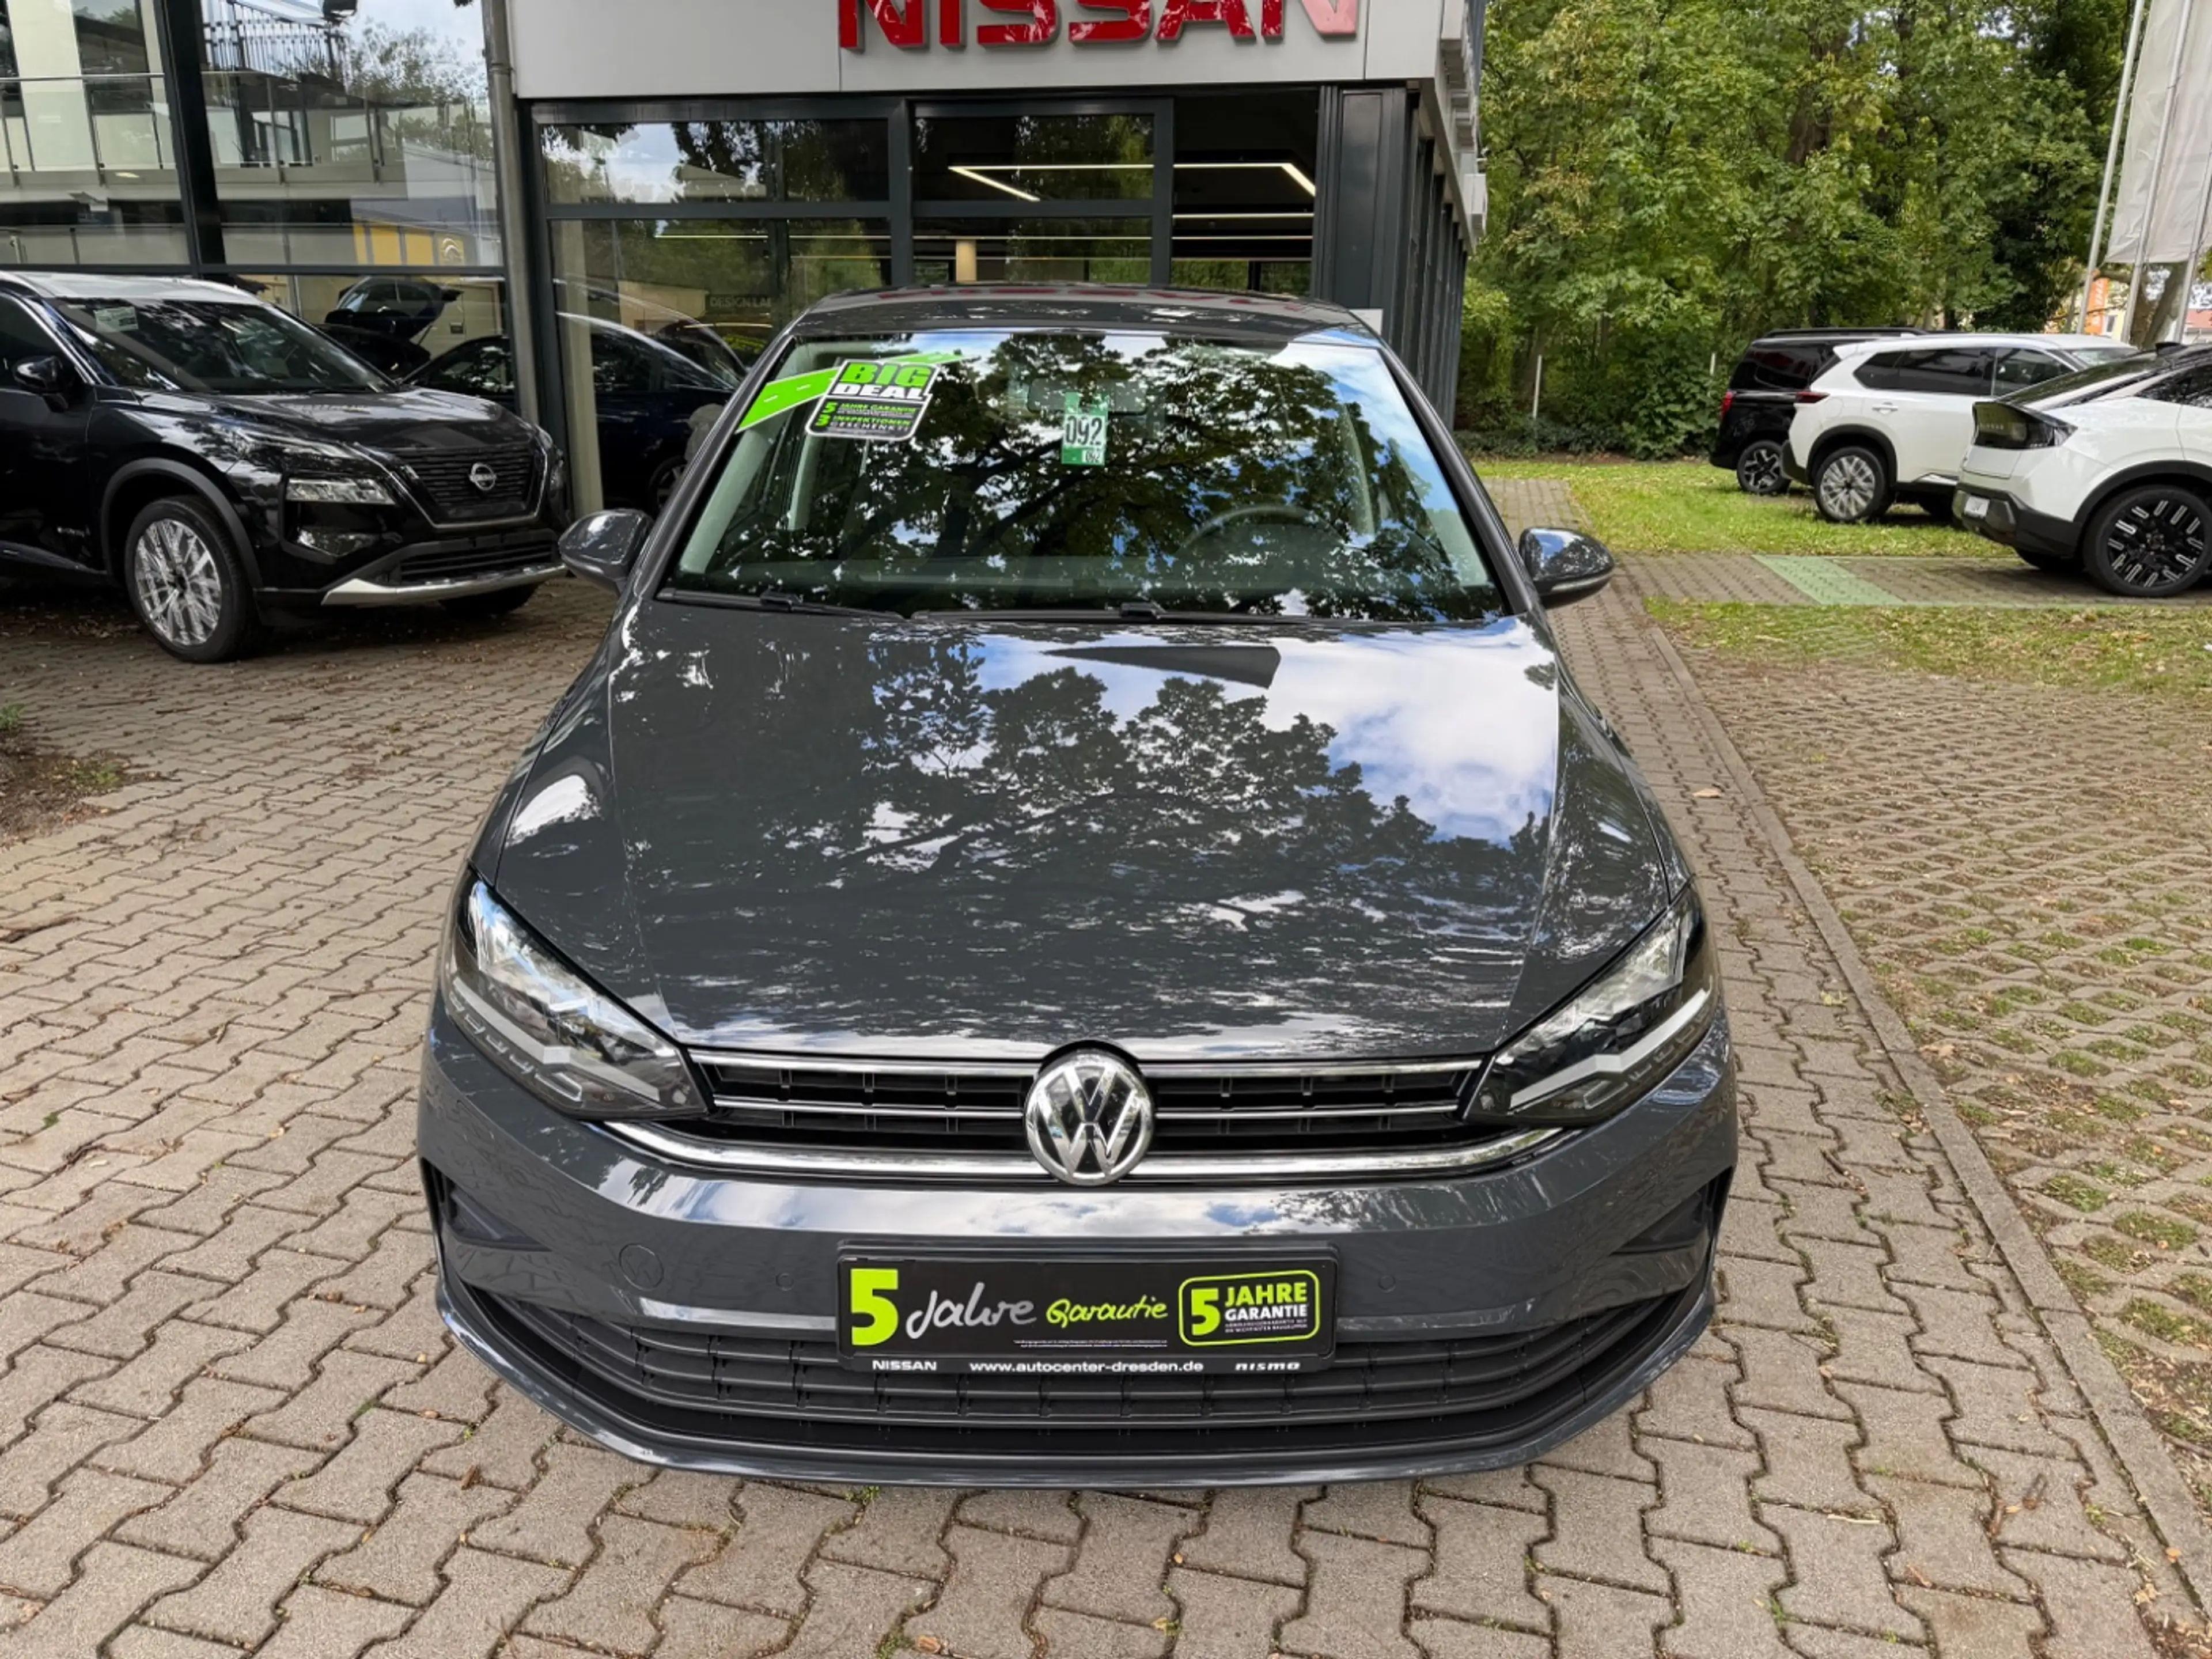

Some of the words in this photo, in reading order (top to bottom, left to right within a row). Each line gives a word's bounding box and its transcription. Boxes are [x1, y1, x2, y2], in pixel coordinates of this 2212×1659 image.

[840, 363, 931, 387] BIG
[831, 383, 923, 399] DEAL
[822, 402, 838, 414] 5
[815, 414, 831, 426] 3
[1066, 415, 1103, 445] 092
[851, 1268, 899, 1346] 5
[906, 1282, 1037, 1339] Jahre
[1191, 1287, 1221, 1336] 5
[1225, 1282, 1308, 1307] JAHRE
[1225, 1304, 1308, 1321] GARANTIE
[872, 1360, 937, 1371] NISSAN
[969, 1361, 1204, 1373] www.autocenter-dresden.de
[1235, 1362, 1301, 1372] nismo
